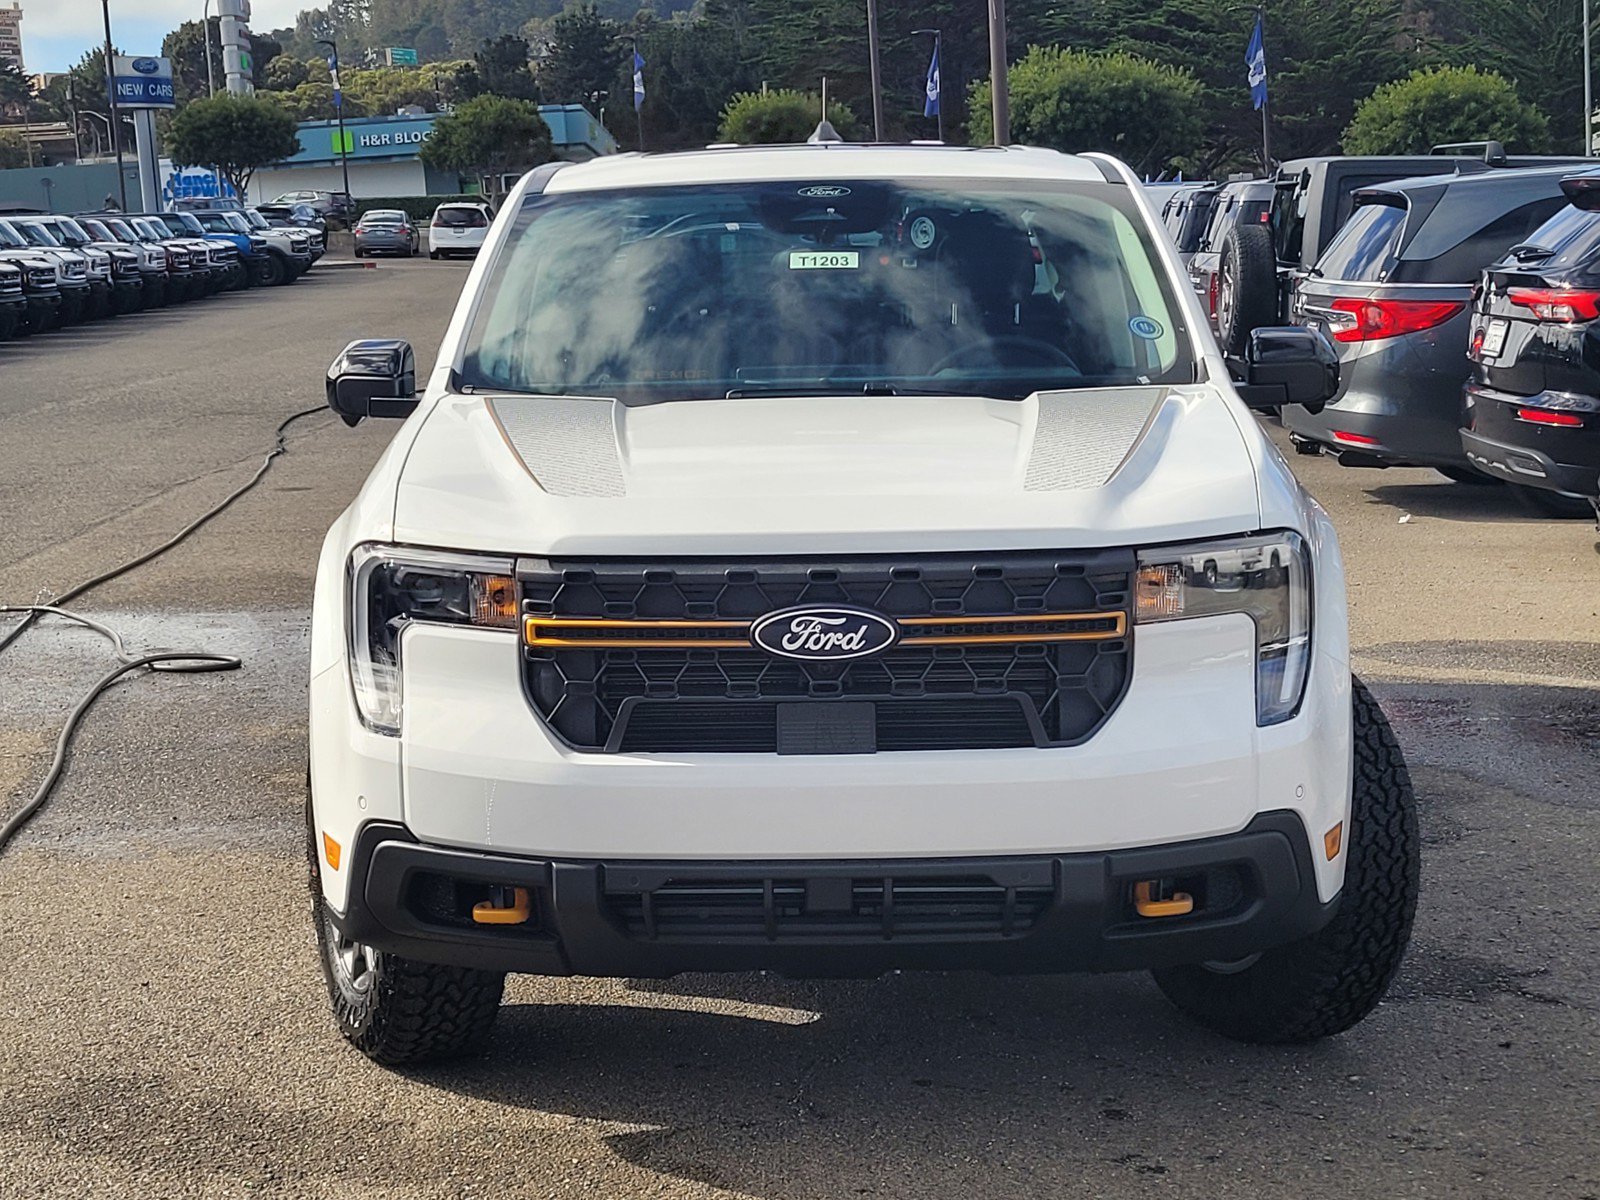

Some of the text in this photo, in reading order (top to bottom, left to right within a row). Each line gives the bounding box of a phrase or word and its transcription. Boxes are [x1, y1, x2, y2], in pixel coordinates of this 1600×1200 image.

[117, 83, 173, 97] NEW CARS
[360, 133, 391, 147] H&R
[806, 187, 842, 196] Ford
[798, 256, 849, 267] T1203
[781, 616, 869, 651] Ford
